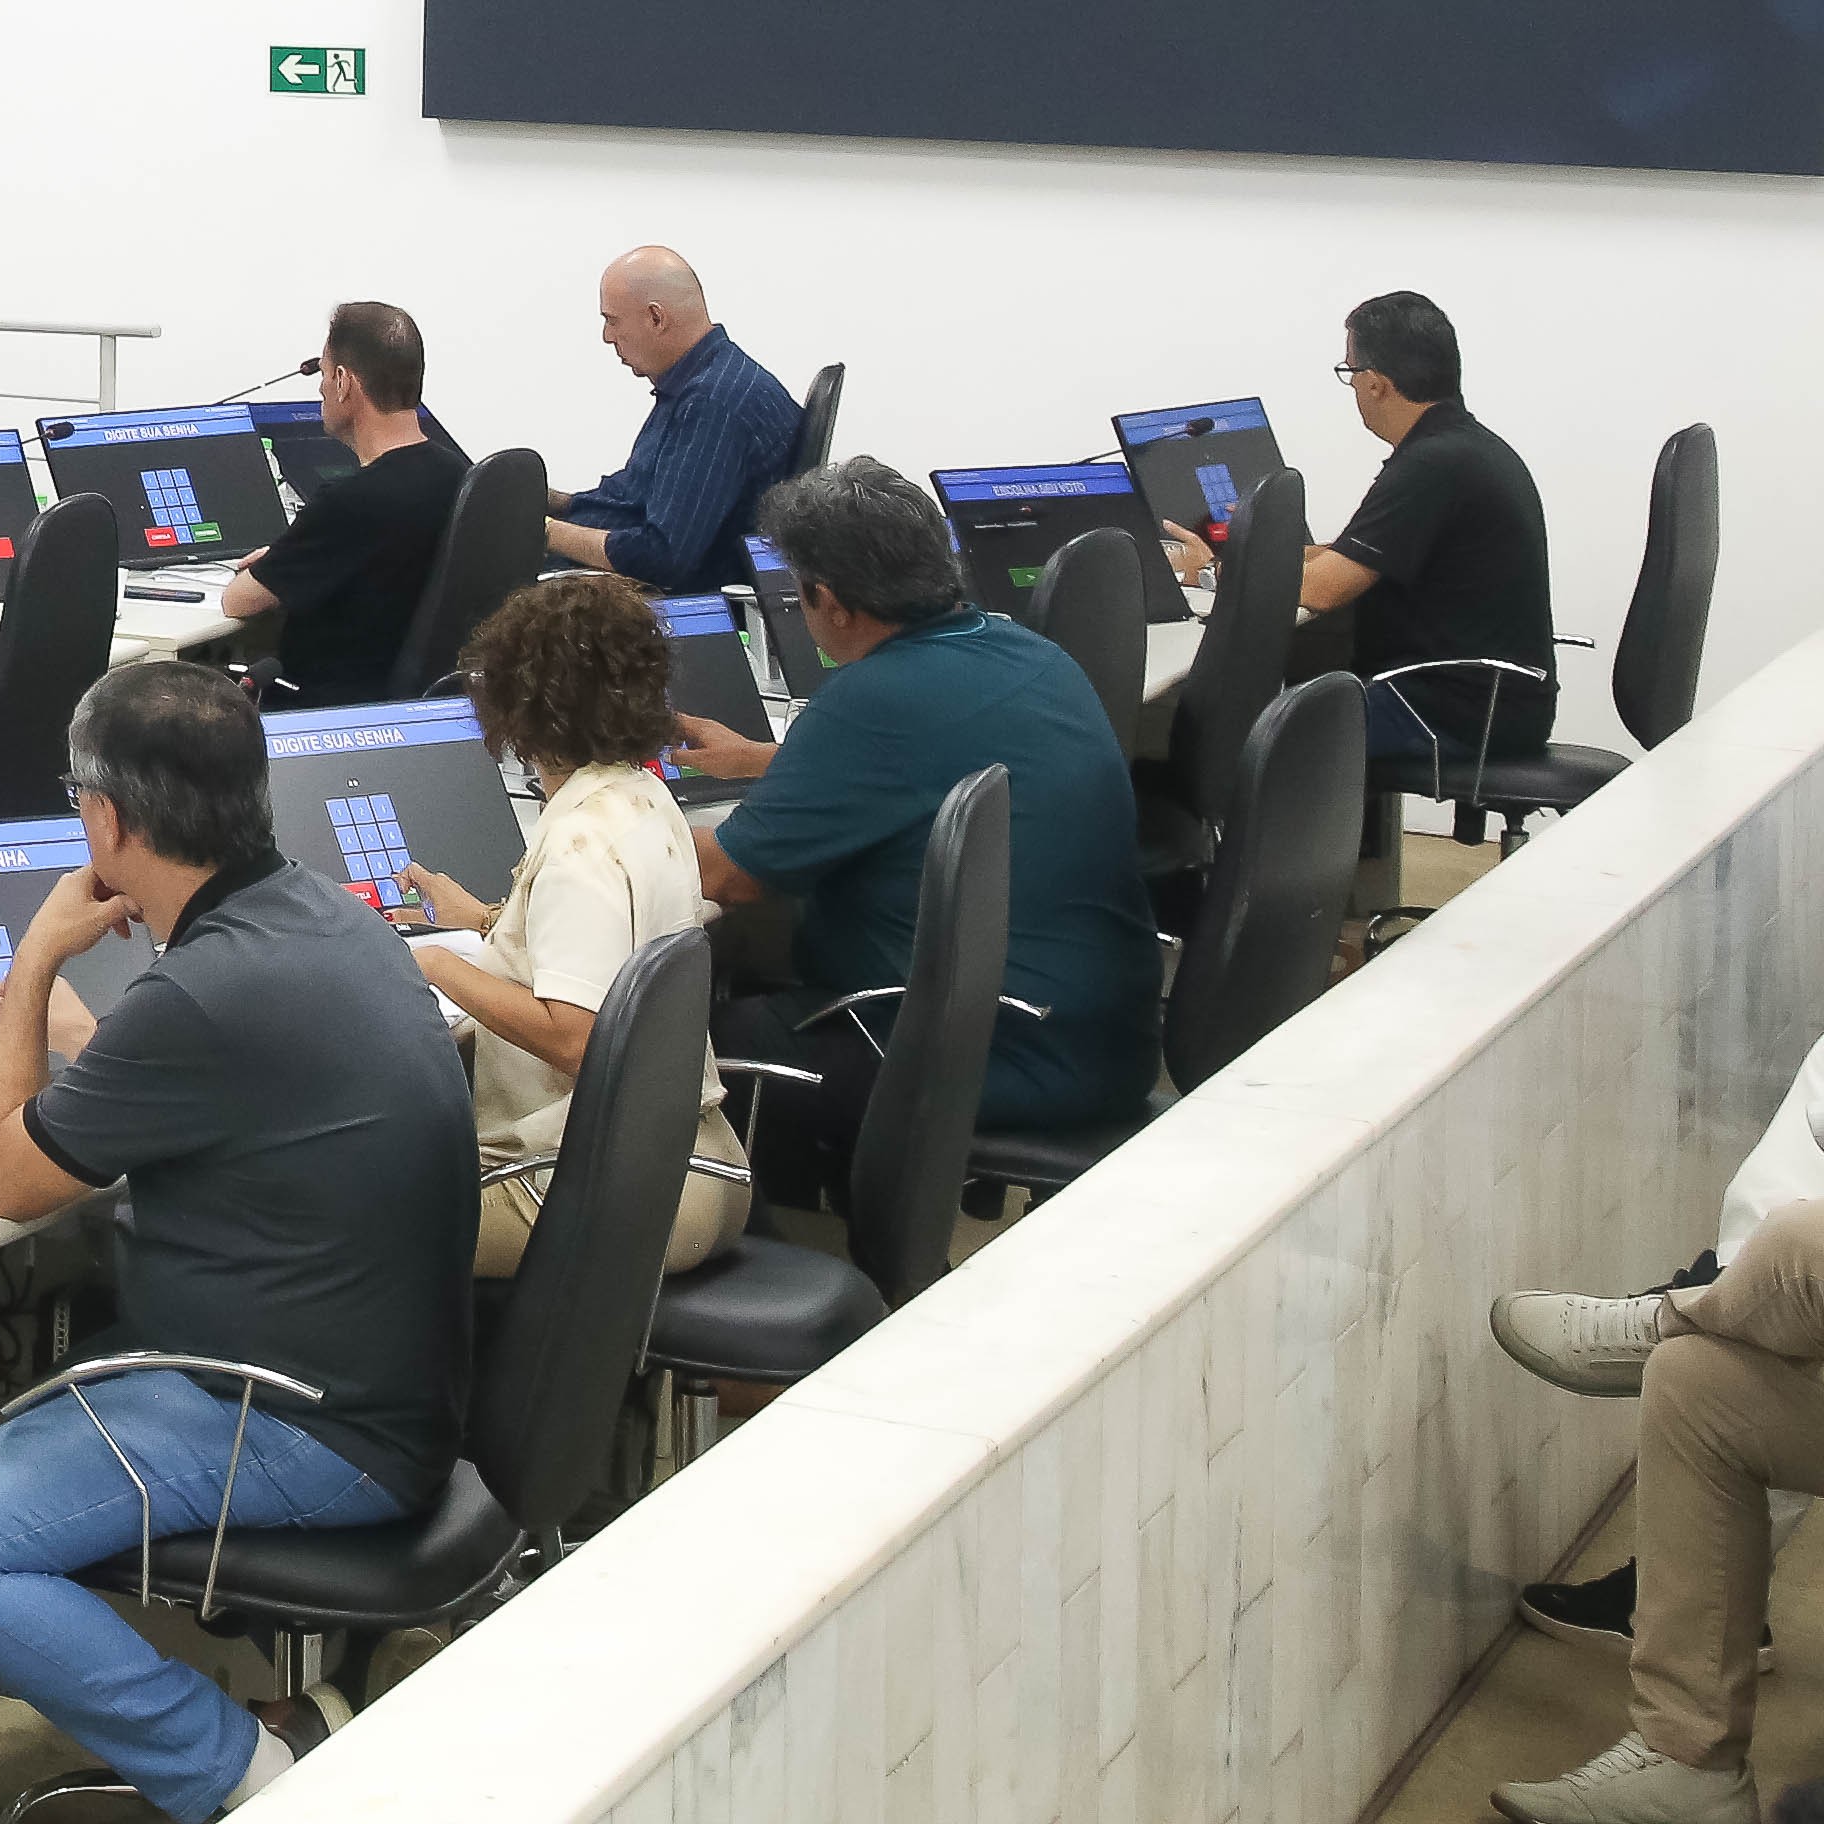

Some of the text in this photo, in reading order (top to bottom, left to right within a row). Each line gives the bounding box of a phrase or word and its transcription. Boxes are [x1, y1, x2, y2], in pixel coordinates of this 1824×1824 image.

[104, 424, 199, 441] DIGITE SUA SENHA
[272, 728, 405, 754] DIGITE SUA SENHA
